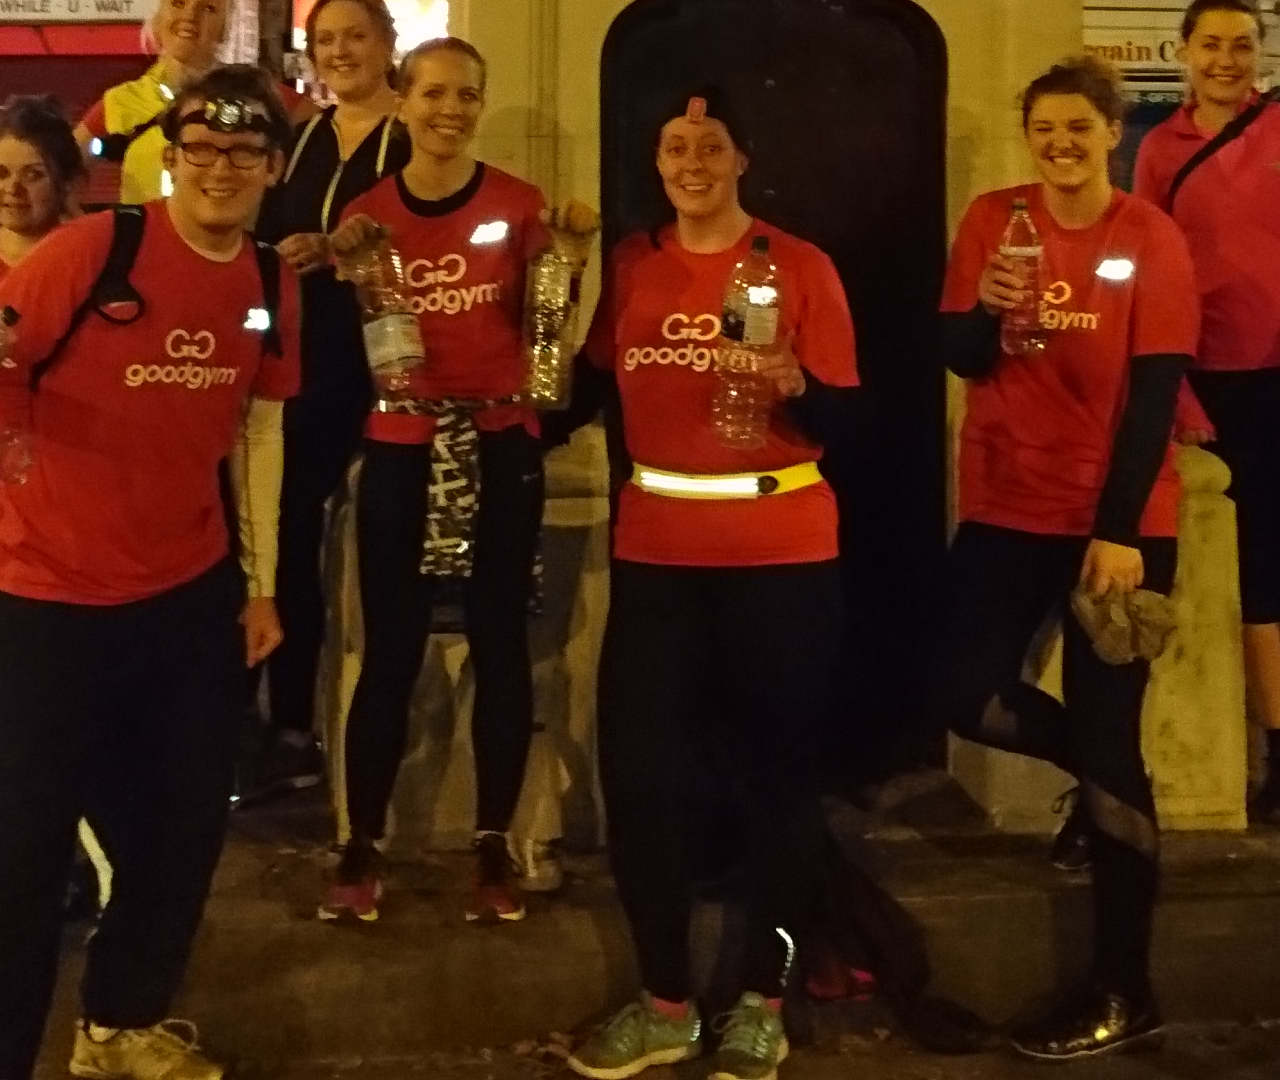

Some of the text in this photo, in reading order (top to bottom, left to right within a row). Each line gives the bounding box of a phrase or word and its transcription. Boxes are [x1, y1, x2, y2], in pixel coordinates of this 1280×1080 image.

[0, 0, 51, 13] WHILE
[67, 1, 81, 13] U
[94, 0, 134, 13] WAIT
[124, 362, 238, 390] goodgym
